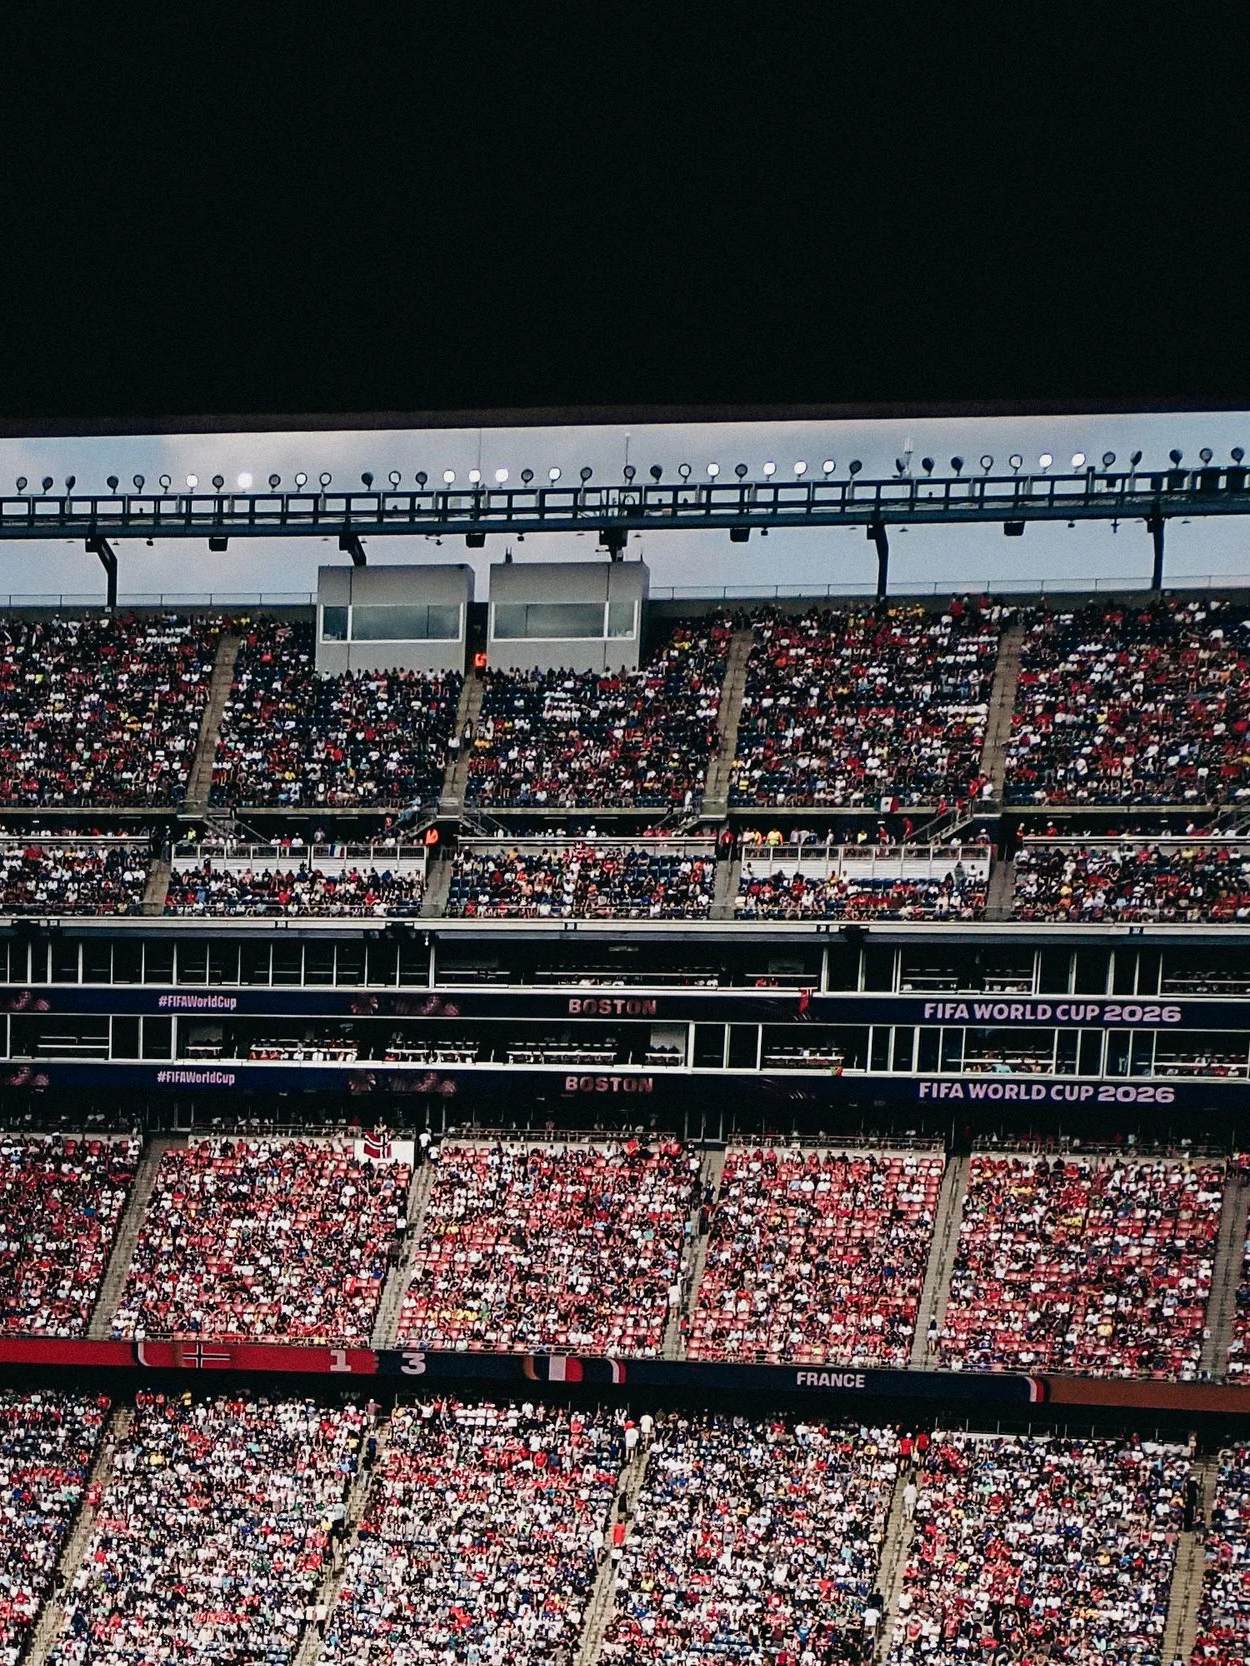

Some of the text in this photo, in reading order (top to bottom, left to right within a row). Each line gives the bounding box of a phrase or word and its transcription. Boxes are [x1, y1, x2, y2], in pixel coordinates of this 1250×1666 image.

[158, 995, 237, 1010] #FIFAWorldCup
[568, 999, 657, 1015] BOSTON
[924, 1003, 1181, 1022] FIFA WORLD CUP 2026
[157, 1071, 235, 1086] #FIFAWorldCup
[565, 1076, 653, 1093] BOSTON
[918, 1082, 1175, 1103] FIFA WORLD CUP 2026
[330, 1350, 352, 1372] 1
[401, 1353, 426, 1374] 3
[796, 1371, 865, 1388] FRANCE
